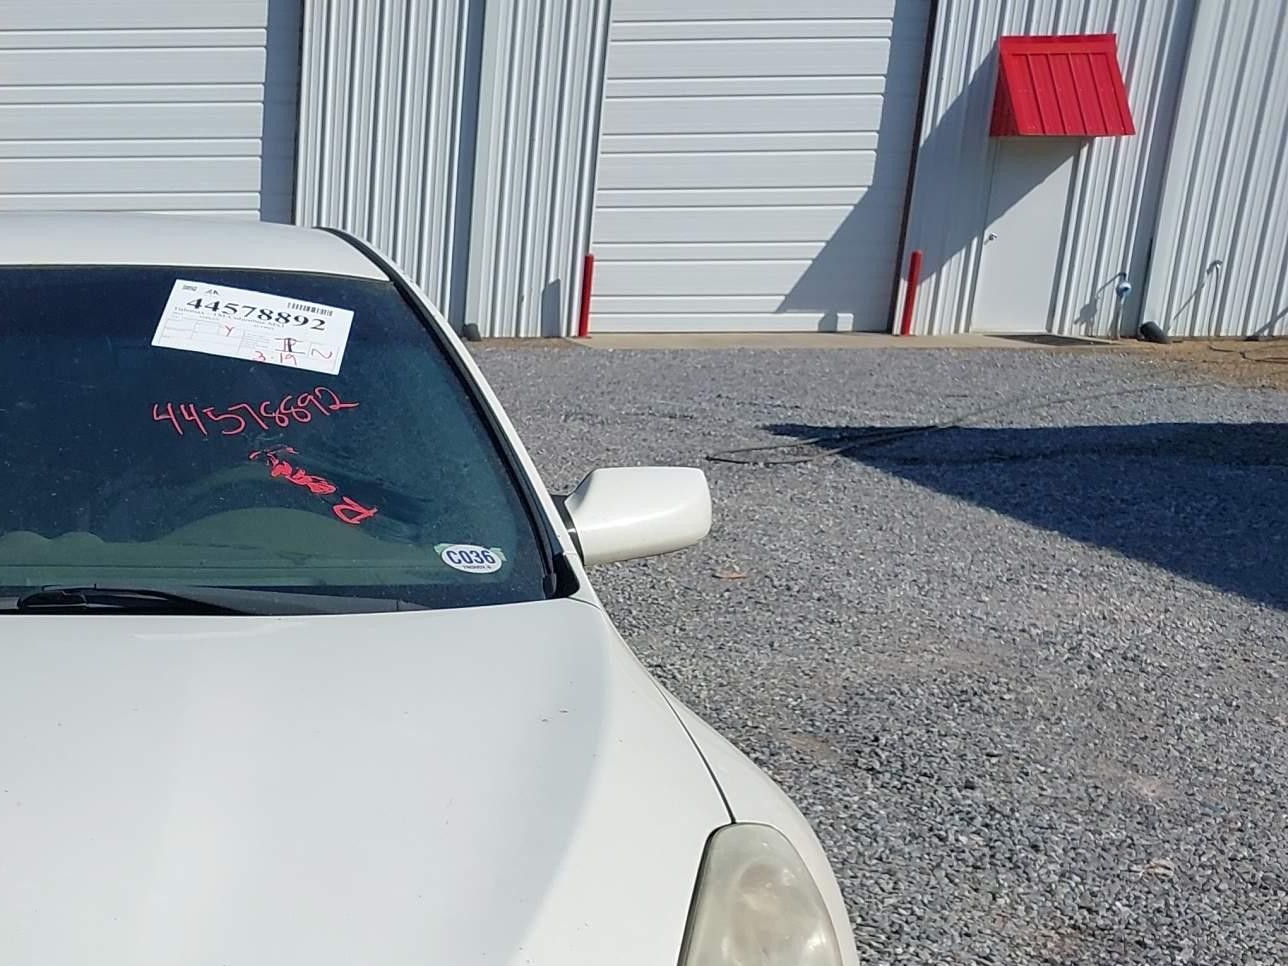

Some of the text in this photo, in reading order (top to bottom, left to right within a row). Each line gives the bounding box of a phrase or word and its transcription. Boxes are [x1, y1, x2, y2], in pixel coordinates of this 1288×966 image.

[186, 297, 326, 331] 44578892
[152, 386, 360, 436] 44578892
[445, 550, 496, 565] C036
